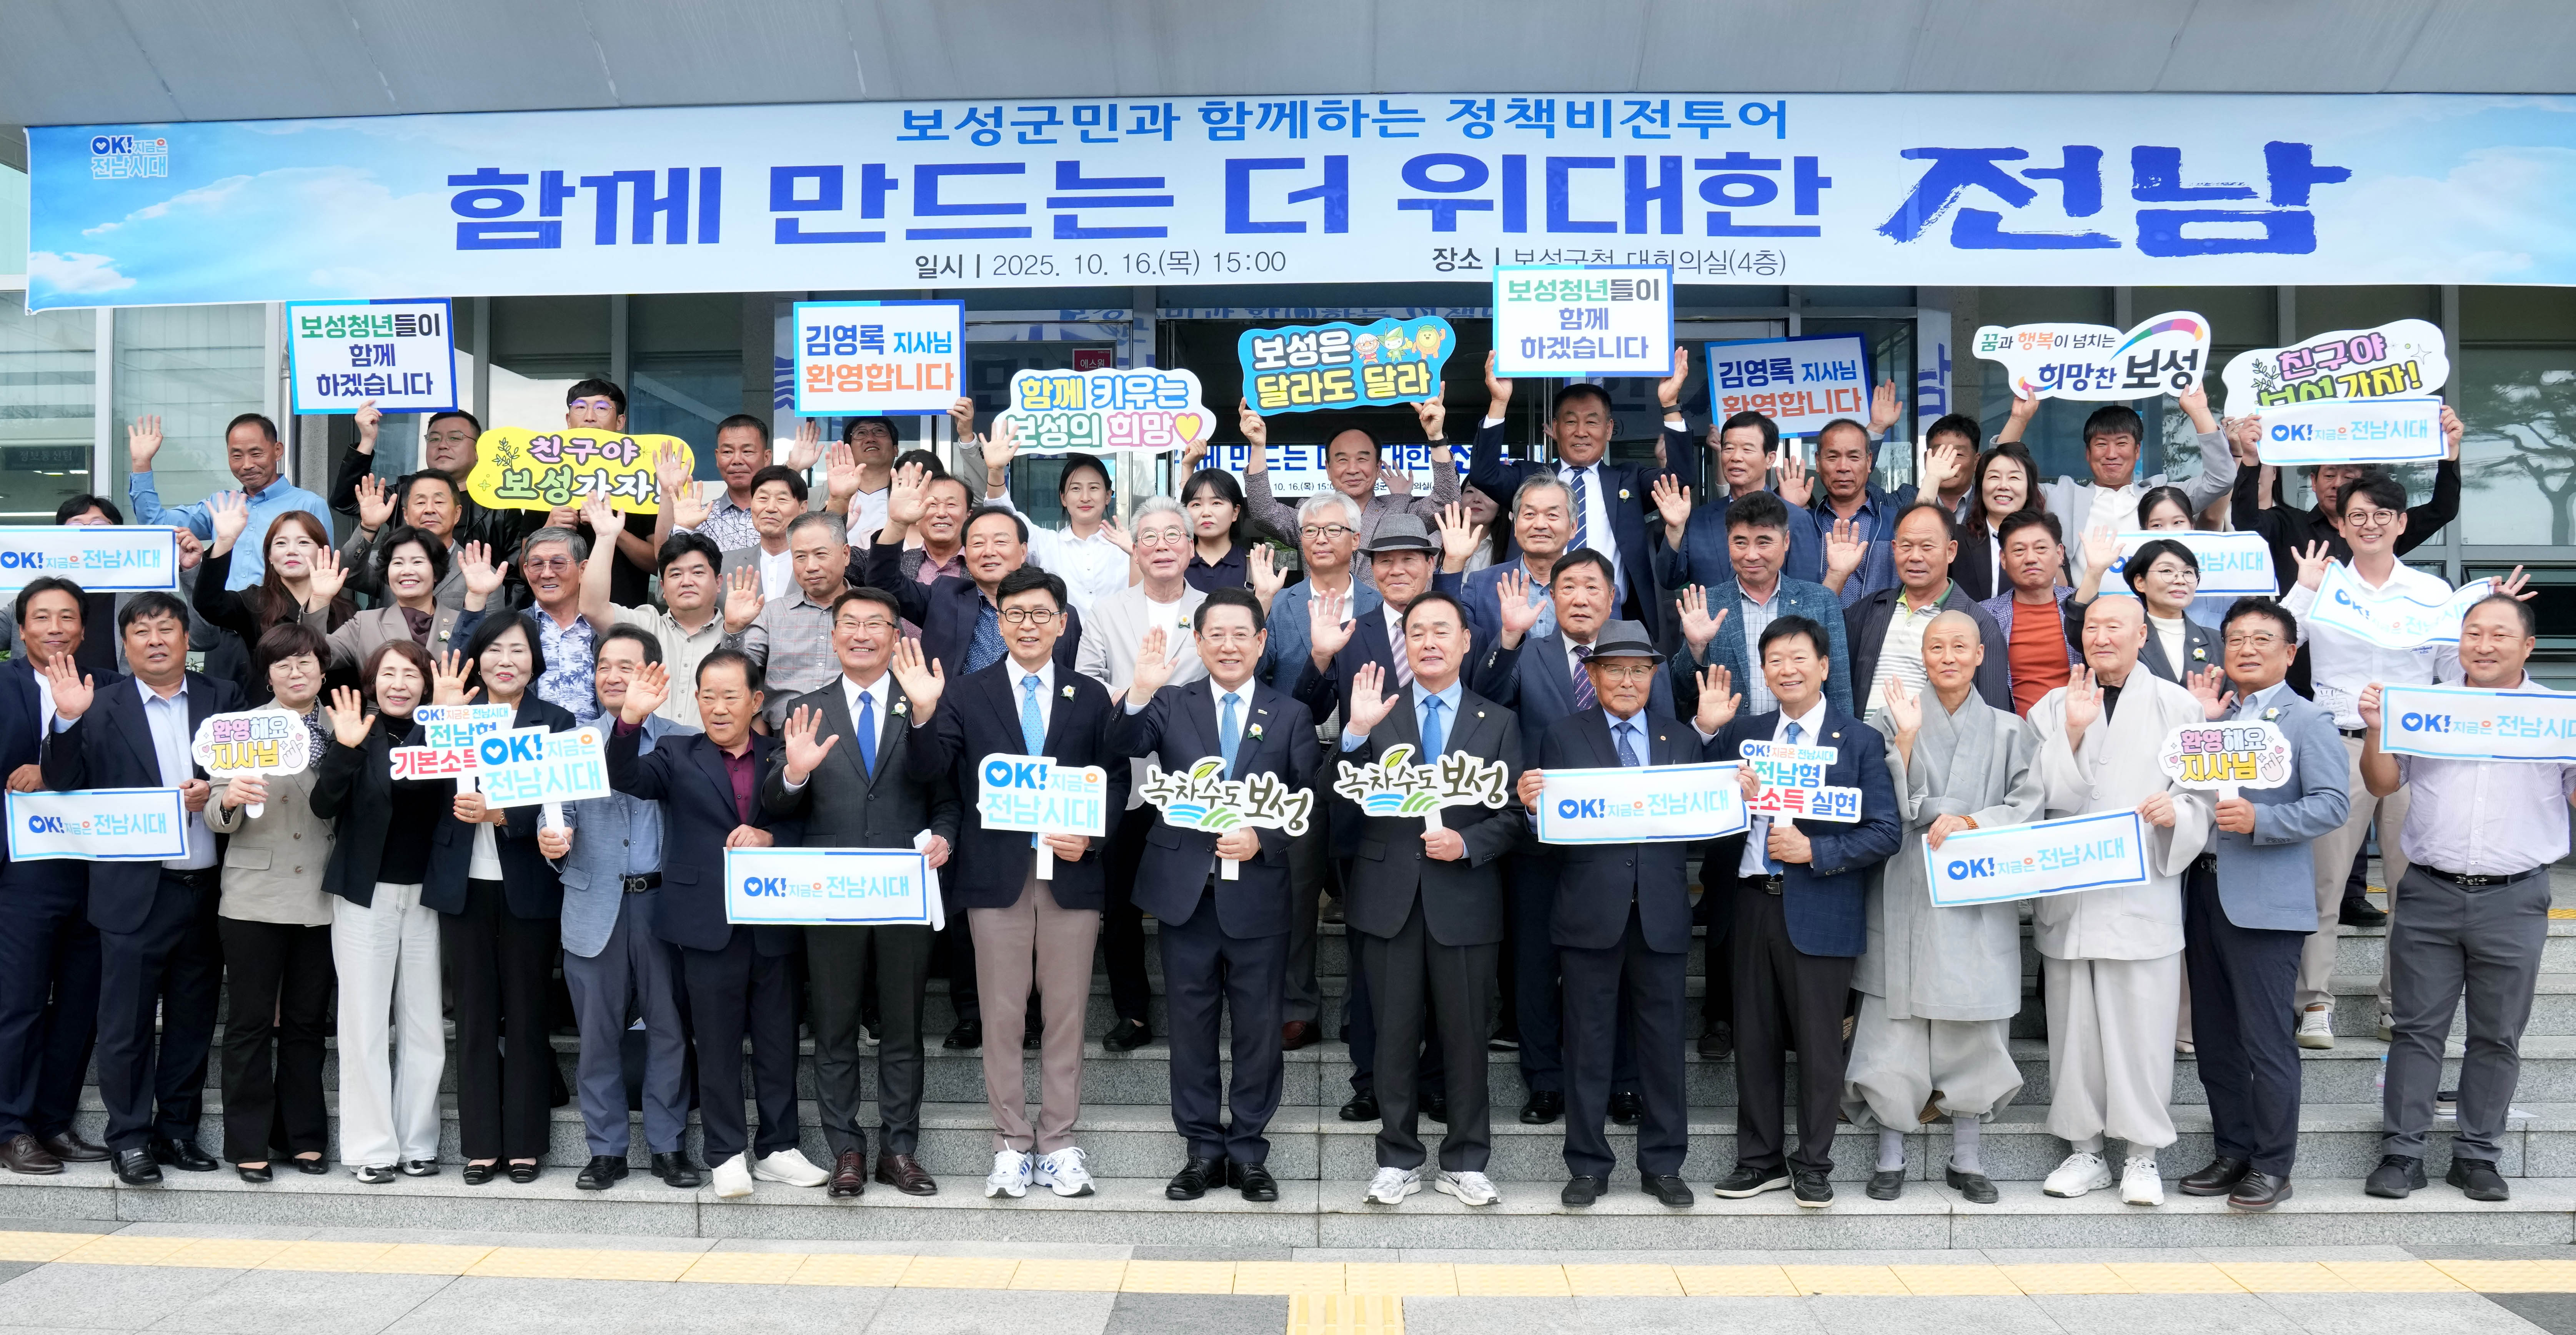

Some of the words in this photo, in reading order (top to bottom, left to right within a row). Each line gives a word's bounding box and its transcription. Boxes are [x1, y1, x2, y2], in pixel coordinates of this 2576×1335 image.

[897, 103, 1181, 146] 보성군민과
[1198, 99, 1425, 141] 함께하는
[1446, 98, 1786, 140] 정책비전투어
[92, 136, 133, 155] OK!
[134, 139, 167, 153] 지금은
[92, 156, 167, 178] 전남시대
[447, 166, 722, 250] 함께
[769, 160, 1174, 244] 만드는
[1225, 155, 1349, 234] 더
[1397, 151, 1832, 237] 위대한
[1873, 141, 2353, 257] 전남
[916, 254, 962, 279] 일시
[994, 255, 1059, 276] 2025.
[1075, 254, 1107, 275] 10.
[1123, 249, 1199, 276] 16.(목)
[1214, 251, 1286, 272] 15:00
[1432, 247, 1483, 272] 장소
[1508, 279, 1659, 301] 보성청년들이
[301, 313, 440, 338] 보성청년들이
[1559, 308, 1609, 330] 함께
[349, 343, 396, 367] 함께
[806, 325, 884, 356] 김영록
[894, 331, 951, 354] 지사님
[1252, 328, 1352, 371] 보성은
[1521, 336, 1649, 360] 하겠습니다
[1981, 334, 2014, 351] 꿈과
[2018, 332, 2068, 350] 행복이
[2073, 334, 2116, 348] 넘치는
[1080, 359, 1105, 369] 에스원
[2038, 363, 2117, 391] 희망찬
[2121, 348, 2199, 390] 보성
[2276, 332, 2387, 381] 친구야
[316, 372, 433, 397] 하겠습니다
[806, 363, 954, 393] 환영합니다
[1257, 369, 1355, 410] 달라도
[1362, 361, 1432, 398] 달라
[1719, 358, 1794, 389] 김영록
[1802, 360, 1856, 382] 지사님
[1019, 376, 1086, 411] 함께
[1091, 375, 1189, 410] 키우는
[1722, 388, 1862, 419] 환영합니다
[1006, 413, 1102, 449] 보성의
[1107, 411, 1174, 446] 희망
[2271, 424, 2312, 441] OK!
[2315, 427, 2347, 440] 지금은
[2351, 420, 2428, 440] 전남시대
[527, 434, 641, 467] 친구야
[0, 551, 43, 569] OK!
[46, 556, 80, 569] 지금은
[83, 549, 160, 569] 전남시대
[417, 709, 444, 721] OK!
[446, 709, 470, 720] 지금은
[472, 707, 508, 718] 전남시대
[2401, 712, 2451, 733] OK!
[2453, 720, 2493, 735] 지금은
[212, 716, 288, 742] 환영해요
[2180, 727, 2266, 754] 환영해요
[211, 739, 280, 770] 지사님
[480, 733, 543, 766] OK!
[546, 734, 596, 757] 지금은
[1743, 744, 1770, 757] OK!
[1772, 747, 1795, 759] 지금은
[1798, 749, 1834, 761] 전남시대
[486, 760, 602, 802] 전남시대
[985, 761, 1047, 790] OK!
[1051, 772, 1099, 792] 지금은
[1441, 756, 1504, 803] 보성
[1755, 761, 1820, 788] 전남형
[2180, 752, 2257, 782] 지사님
[985, 794, 1099, 830] 전남시대
[1248, 777, 1309, 831] 보성
[1558, 799, 1605, 819] OK!
[1608, 801, 1644, 817] 지금은
[1648, 790, 1728, 816] 전남시대
[1812, 791, 1857, 817] 실현
[29, 815, 64, 834] OK!
[65, 820, 92, 835] 지금은
[94, 813, 167, 835] 전남시대
[1947, 857, 1995, 881] OK!
[1998, 857, 2036, 875] 지금은
[2038, 837, 2125, 871] 전남시대
[744, 877, 786, 897] OK!
[789, 882, 823, 897] 지금은
[827, 876, 909, 898] 전남시대
